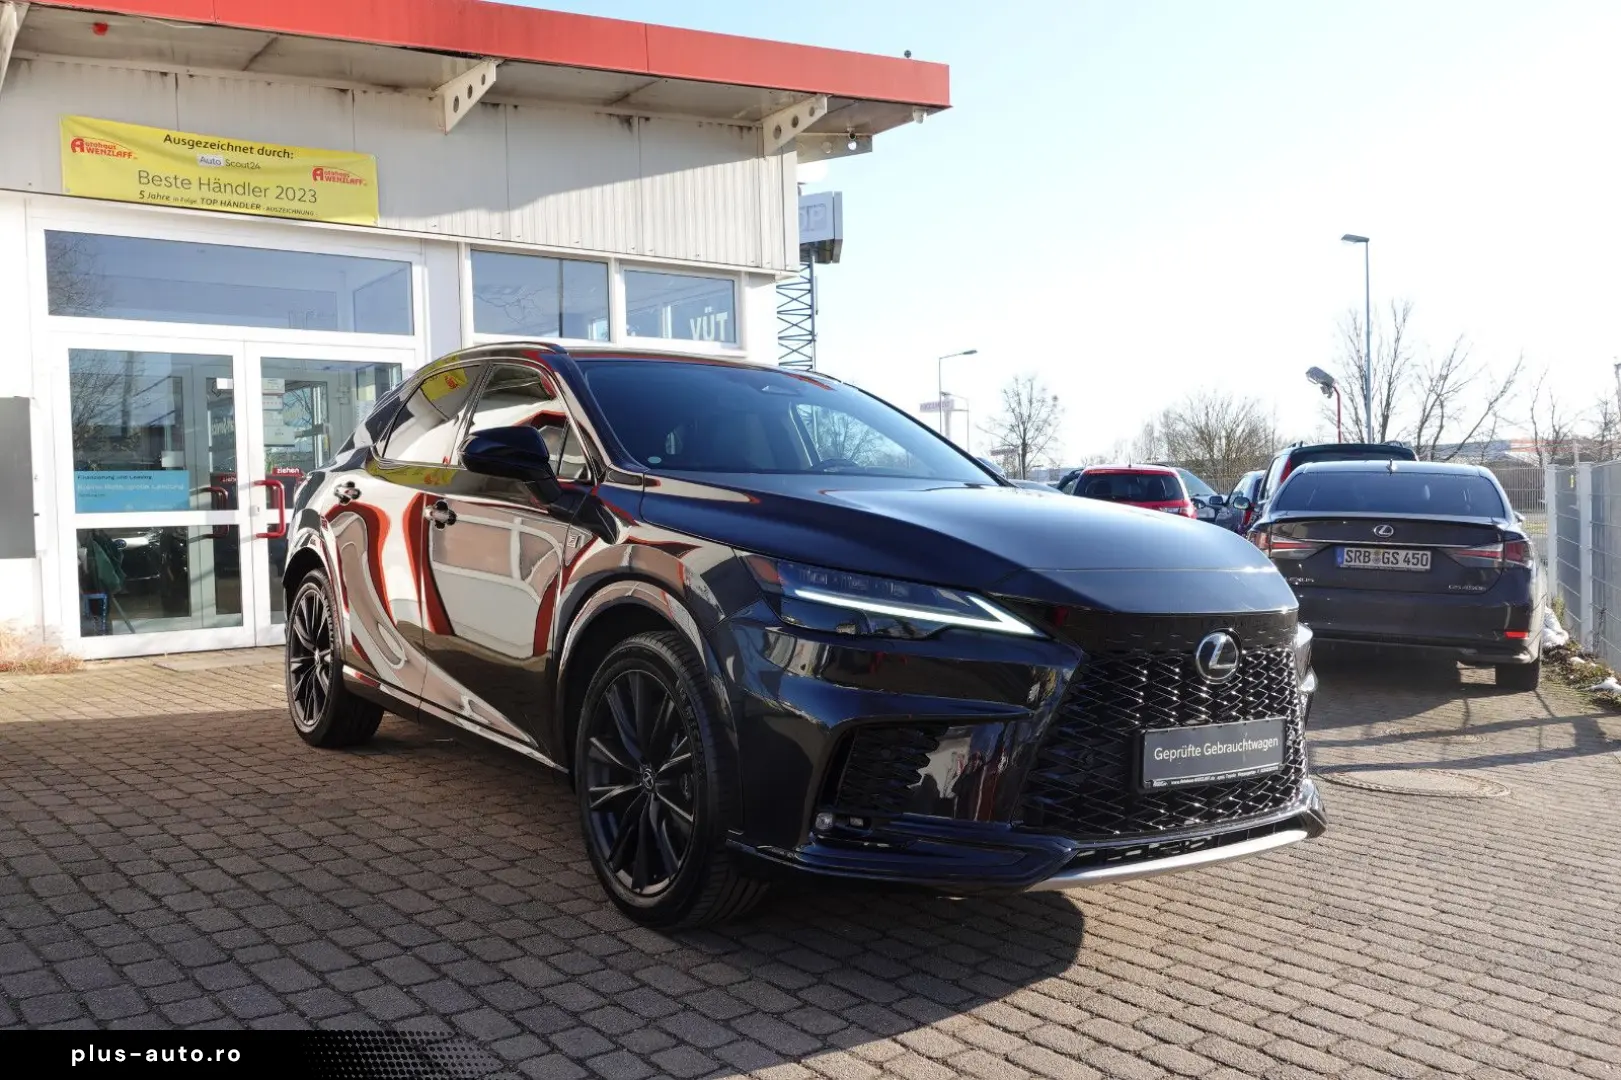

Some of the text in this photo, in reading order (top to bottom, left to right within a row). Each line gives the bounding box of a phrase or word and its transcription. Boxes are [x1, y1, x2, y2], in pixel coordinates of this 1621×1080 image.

[86, 147, 133, 159] WENZLAFF
[163, 134, 294, 159] Ausgezeichnet durch:
[200, 156, 261, 170] Auto Scout24
[138, 169, 317, 204] Beste Händler 2023
[324, 175, 363, 186] WENZLAFF
[139, 190, 145, 200] 5
[147, 191, 170, 201] Jahre
[200, 197, 219, 206] TOP
[220, 198, 262, 210] HÄNDLER
[277, 465, 300, 474] ziehen
[1345, 549, 1429, 567] SRB GS 450
[1154, 738, 1279, 762] Geprüfte Gebrauchtwagen
